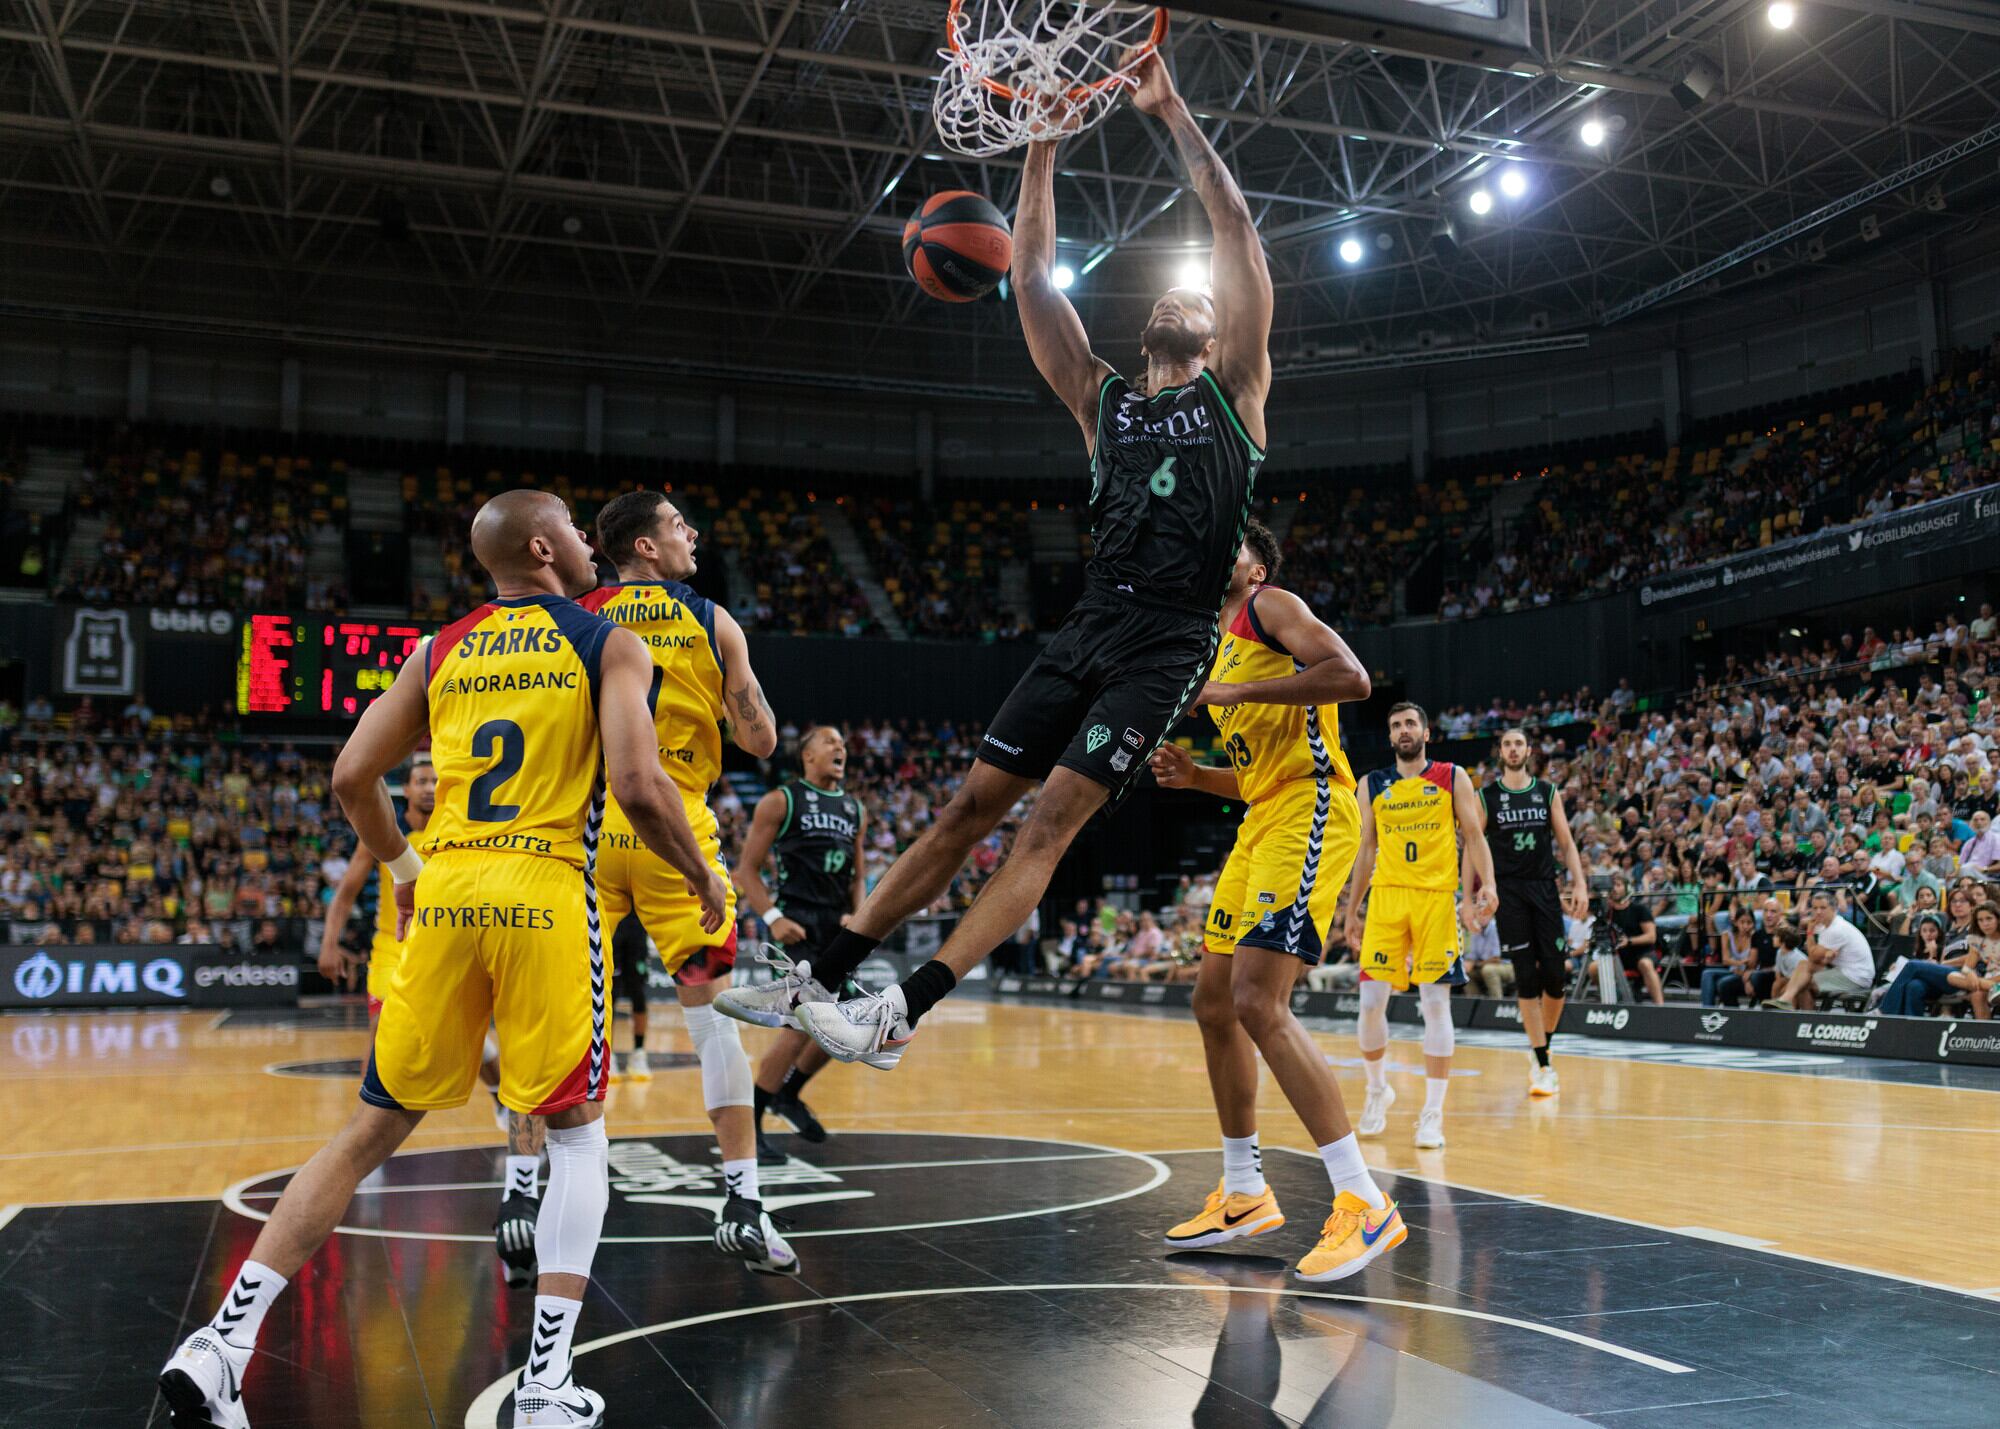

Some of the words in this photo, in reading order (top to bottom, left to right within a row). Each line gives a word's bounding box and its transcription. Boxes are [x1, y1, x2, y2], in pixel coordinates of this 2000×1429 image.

[1150, 457, 1176, 497] 6
[1983, 503, 2000, 517] BIL
[1863, 512, 1960, 549] @CDBILBAOBASKET
[459, 627, 562, 659] STARKS
[643, 635, 696, 648] ABANC
[459, 672, 577, 694] MORABANC
[990, 737, 1019, 755] CORREO
[1125, 734, 1138, 745] acb
[467, 719, 525, 822] 2
[1496, 807, 1547, 824] surne
[1406, 841, 1418, 862] 0
[1513, 832, 1537, 851] 34
[824, 848, 847, 873] 19
[66, 958, 187, 998] IMQ
[194, 960, 298, 987] endesa
[1586, 1009, 1614, 1025] bbk
[1797, 1023, 1813, 1038] EL
[1814, 1024, 1870, 1042] CORREO
[1948, 1035, 2000, 1051] comunita
